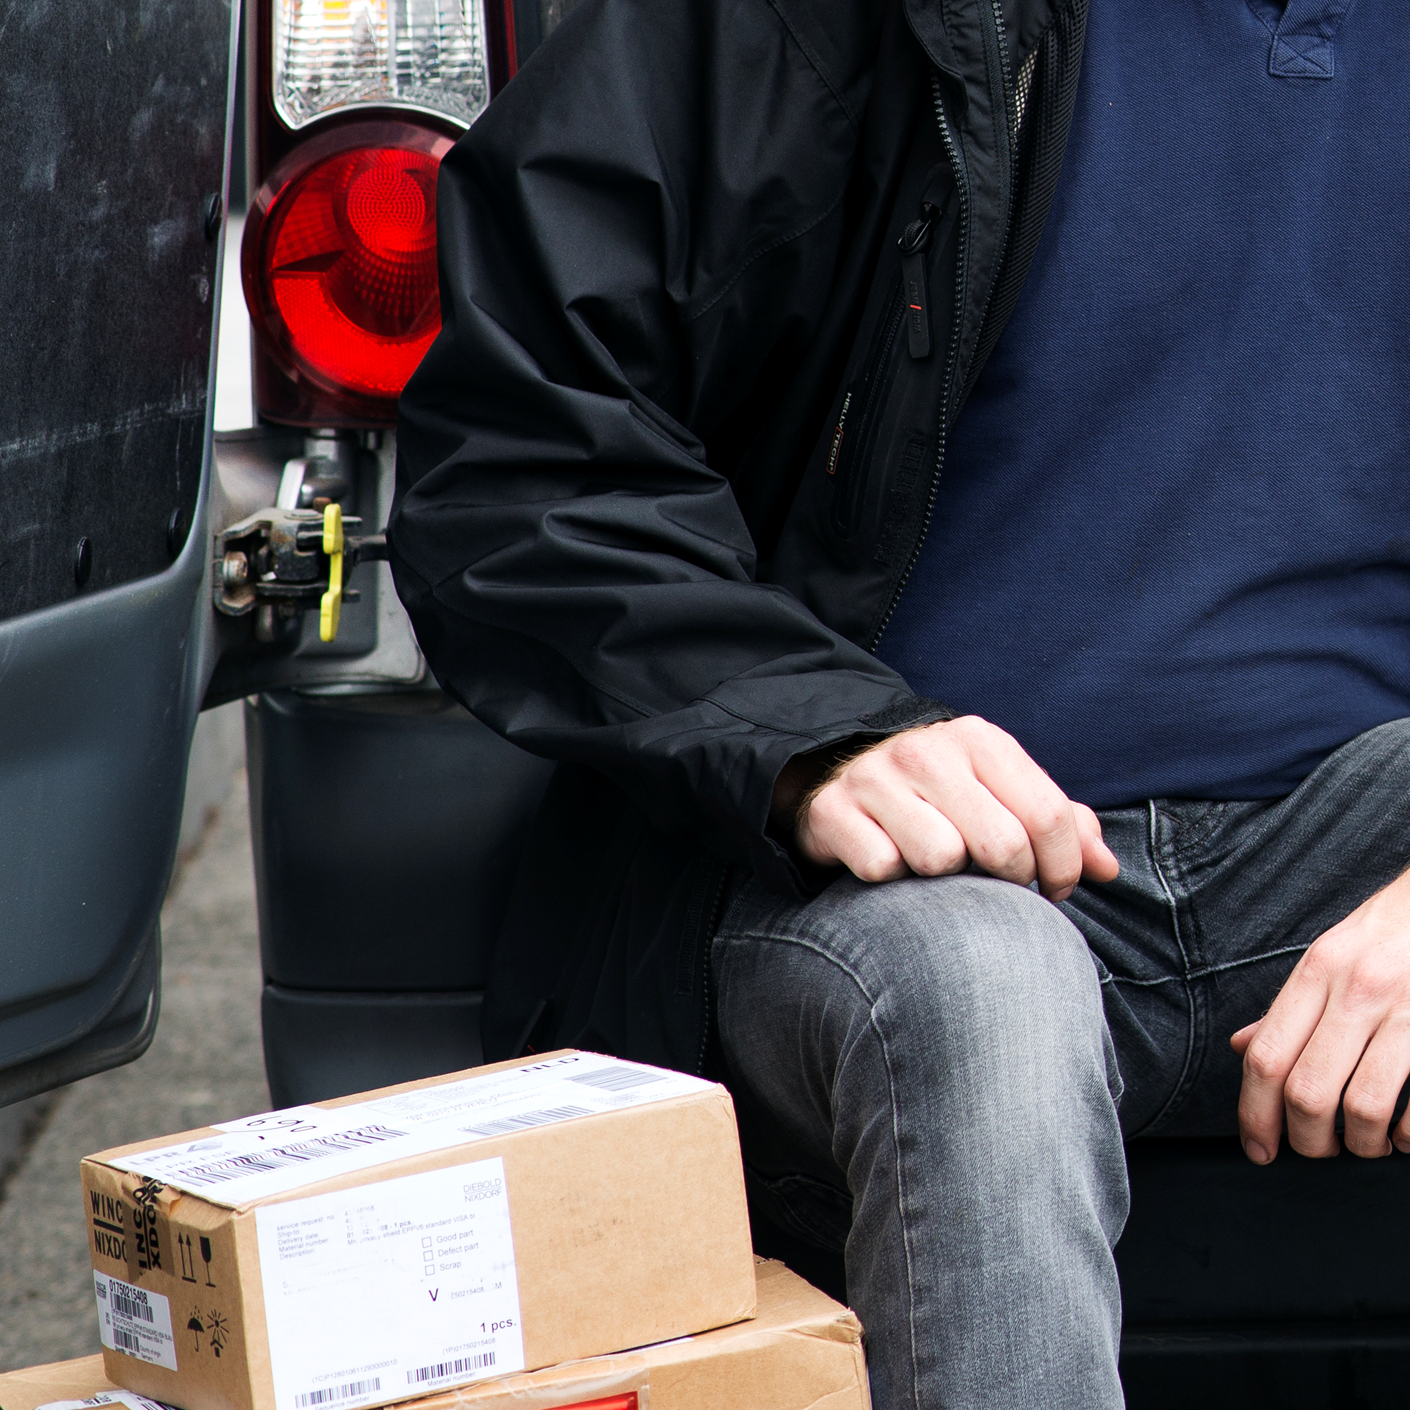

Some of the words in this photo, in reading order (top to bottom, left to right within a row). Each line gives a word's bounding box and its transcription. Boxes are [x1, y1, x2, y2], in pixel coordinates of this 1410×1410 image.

[519, 1057, 581, 1074] NLD
[462, 1177, 502, 1193] DIEBOLD
[463, 1187, 503, 1203] NIXDORF
[275, 1220, 299, 1232] service
[299, 1215, 324, 1228] request
[382, 1228, 400, 1238] shield
[424, 1217, 452, 1229] standard
[452, 1214, 468, 1223] VISA
[277, 1234, 303, 1247] Delivery
[435, 1231, 457, 1244] Good
[458, 1229, 474, 1240] part
[278, 1241, 303, 1253] Material
[437, 1244, 462, 1257] Defect
[463, 1241, 479, 1253] part
[439, 1259, 462, 1272] Scrap
[479, 1322, 486, 1333] 1
[490, 1316, 517, 1333] pcs.
